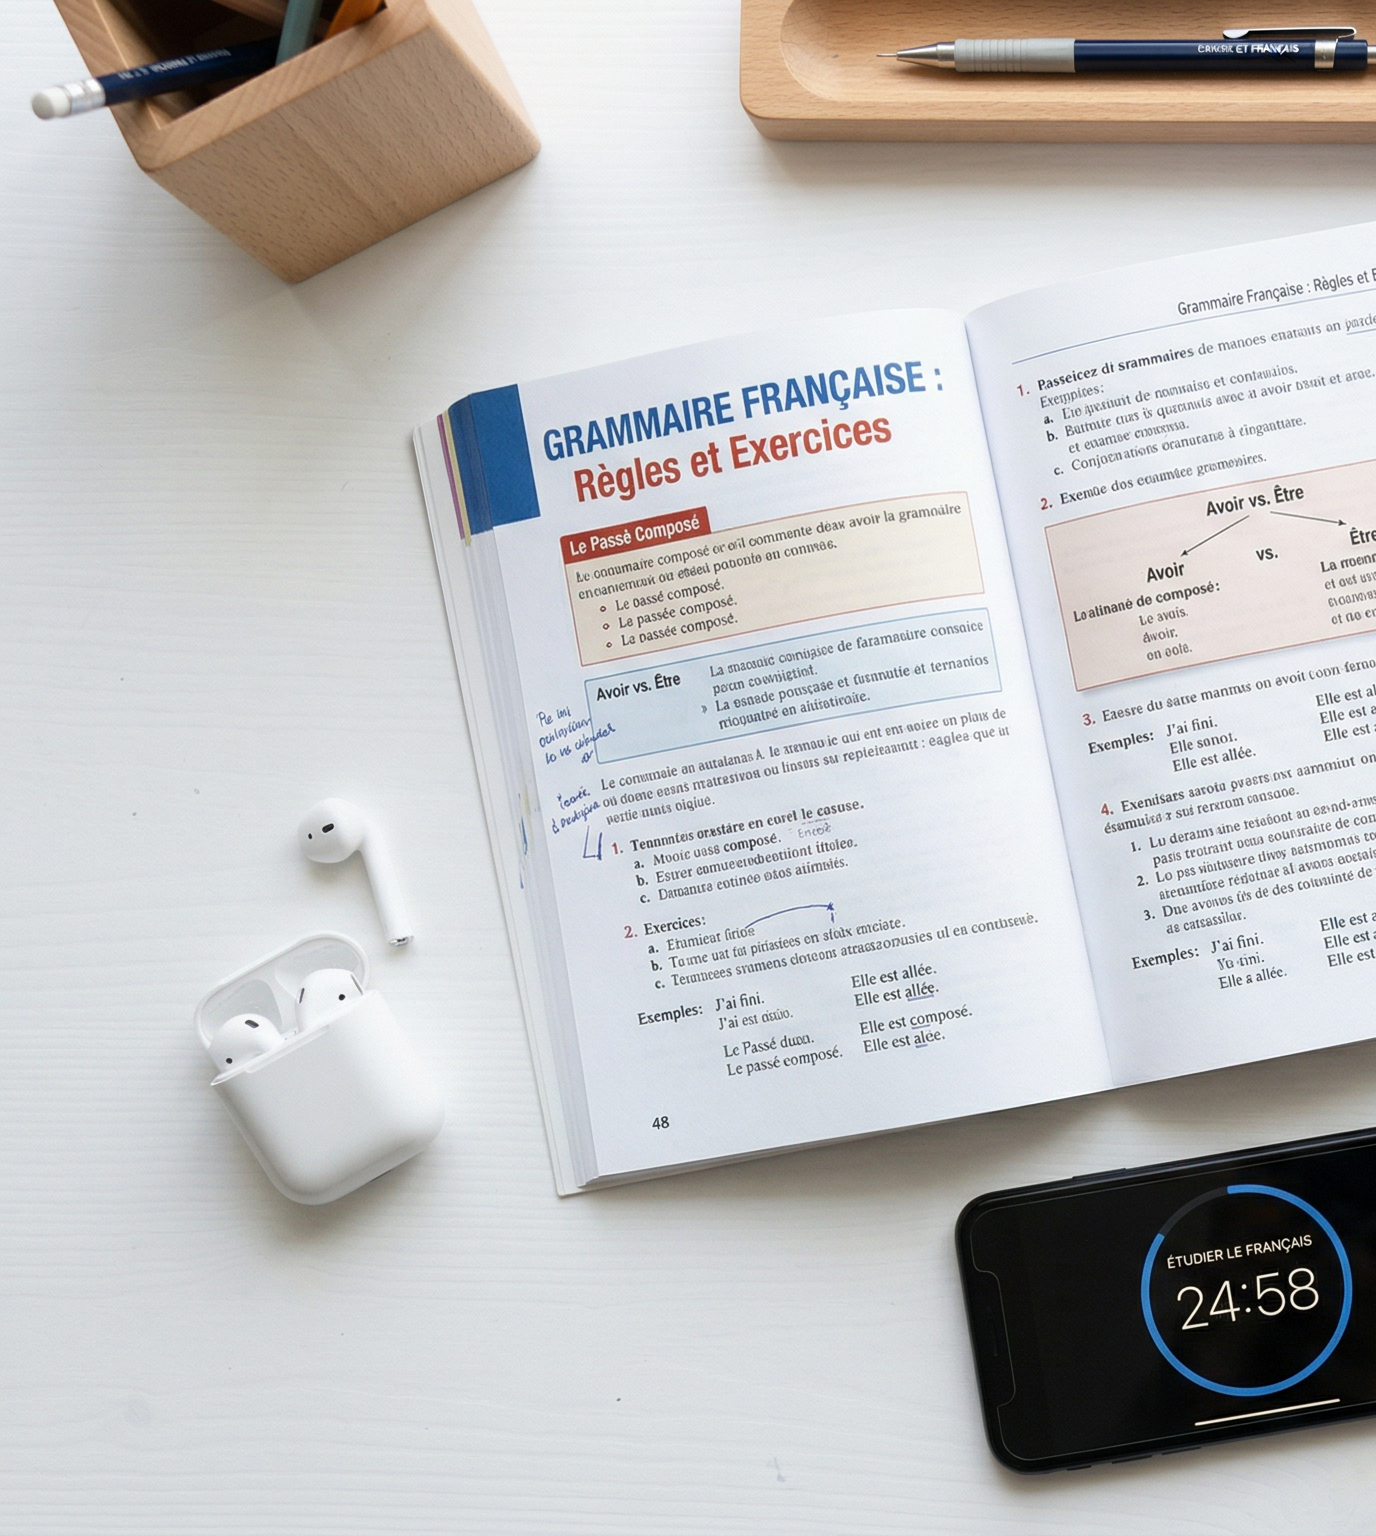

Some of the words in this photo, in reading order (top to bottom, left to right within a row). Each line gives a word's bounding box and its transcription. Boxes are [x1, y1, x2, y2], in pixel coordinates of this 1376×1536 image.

[1176, 291, 1244, 316] Grammaire
[1245, 282, 1304, 304] Française
[1312, 273, 1354, 292] Règles
[1356, 270, 1370, 285] et
[542, 390, 735, 462] GRAMMAIRE
[740, 360, 927, 419] FRANÇAISE
[573, 456, 682, 503] Règles
[689, 441, 724, 478] et
[728, 416, 892, 470] Exercices
[1205, 495, 1245, 517] Avoir
[1247, 493, 1271, 508] vs.
[1272, 483, 1305, 504] Être
[569, 540, 587, 556] Le
[634, 513, 700, 542] Composé
[656, 544, 710, 566] composé
[848, 513, 881, 528] avoir
[1254, 547, 1279, 562] vs.
[1146, 561, 1185, 584] Avoir
[666, 577, 725, 601] composé.
[1154, 580, 1220, 604] composé:
[636, 606, 676, 629] passée
[678, 593, 738, 616] composé.
[679, 611, 739, 634] composé.
[596, 682, 630, 702] Avoir
[631, 680, 652, 694] vs.
[653, 672, 681, 690] Être
[1314, 691, 1342, 707] Elle
[1343, 687, 1363, 702] est
[1081, 712, 1096, 727] 3.
[1318, 709, 1345, 725] Elle
[1347, 705, 1368, 719] est
[1087, 731, 1155, 755] Exemples:
[1166, 720, 1189, 737] J'ai
[1190, 715, 1218, 732] fini.
[1322, 726, 1349, 743] Elle
[1351, 723, 1371, 737] est
[1168, 738, 1194, 755] Elle
[1171, 756, 1198, 773] Elle
[1221, 745, 1257, 763] allée.
[722, 832, 782, 853] composé.
[623, 924, 638, 939] 2.
[642, 915, 706, 936] Exercices:
[1318, 915, 1346, 932] Elle
[1348, 911, 1369, 926] est
[1130, 947, 1200, 970] Exemples:
[1210, 936, 1234, 954] J'ai
[1236, 931, 1264, 949] fini.
[1322, 933, 1350, 950] Elle
[1352, 929, 1371, 944] est
[1326, 951, 1354, 968] Elle
[1356, 947, 1376, 962] est
[850, 972, 877, 989] Elle
[878, 969, 899, 984] est
[901, 962, 937, 980] allée.
[1217, 973, 1243, 990] Elle
[714, 994, 737, 1012] J'ai
[738, 990, 765, 1008] fini.
[853, 990, 880, 1007] Elle
[882, 988, 902, 1002] est
[904, 981, 940, 999] allée.
[718, 1014, 739, 1031] J'ai
[741, 1013, 759, 1026] est
[858, 1019, 885, 1036] Elle
[887, 1016, 907, 1030] est
[909, 1003, 973, 1030] composé.
[741, 1035, 777, 1055] Passé
[862, 1037, 889, 1053] Elle
[890, 1034, 911, 1048] est
[745, 1055, 781, 1076] passé
[782, 1044, 843, 1067] composé.
[651, 1114, 670, 1130] 48
[1166, 1248, 1224, 1269] ÉTUDIER
[1225, 1245, 1243, 1259] LE
[1245, 1233, 1313, 1256] FRANÇAIS
[1176, 1267, 1319, 1331] 24:58
